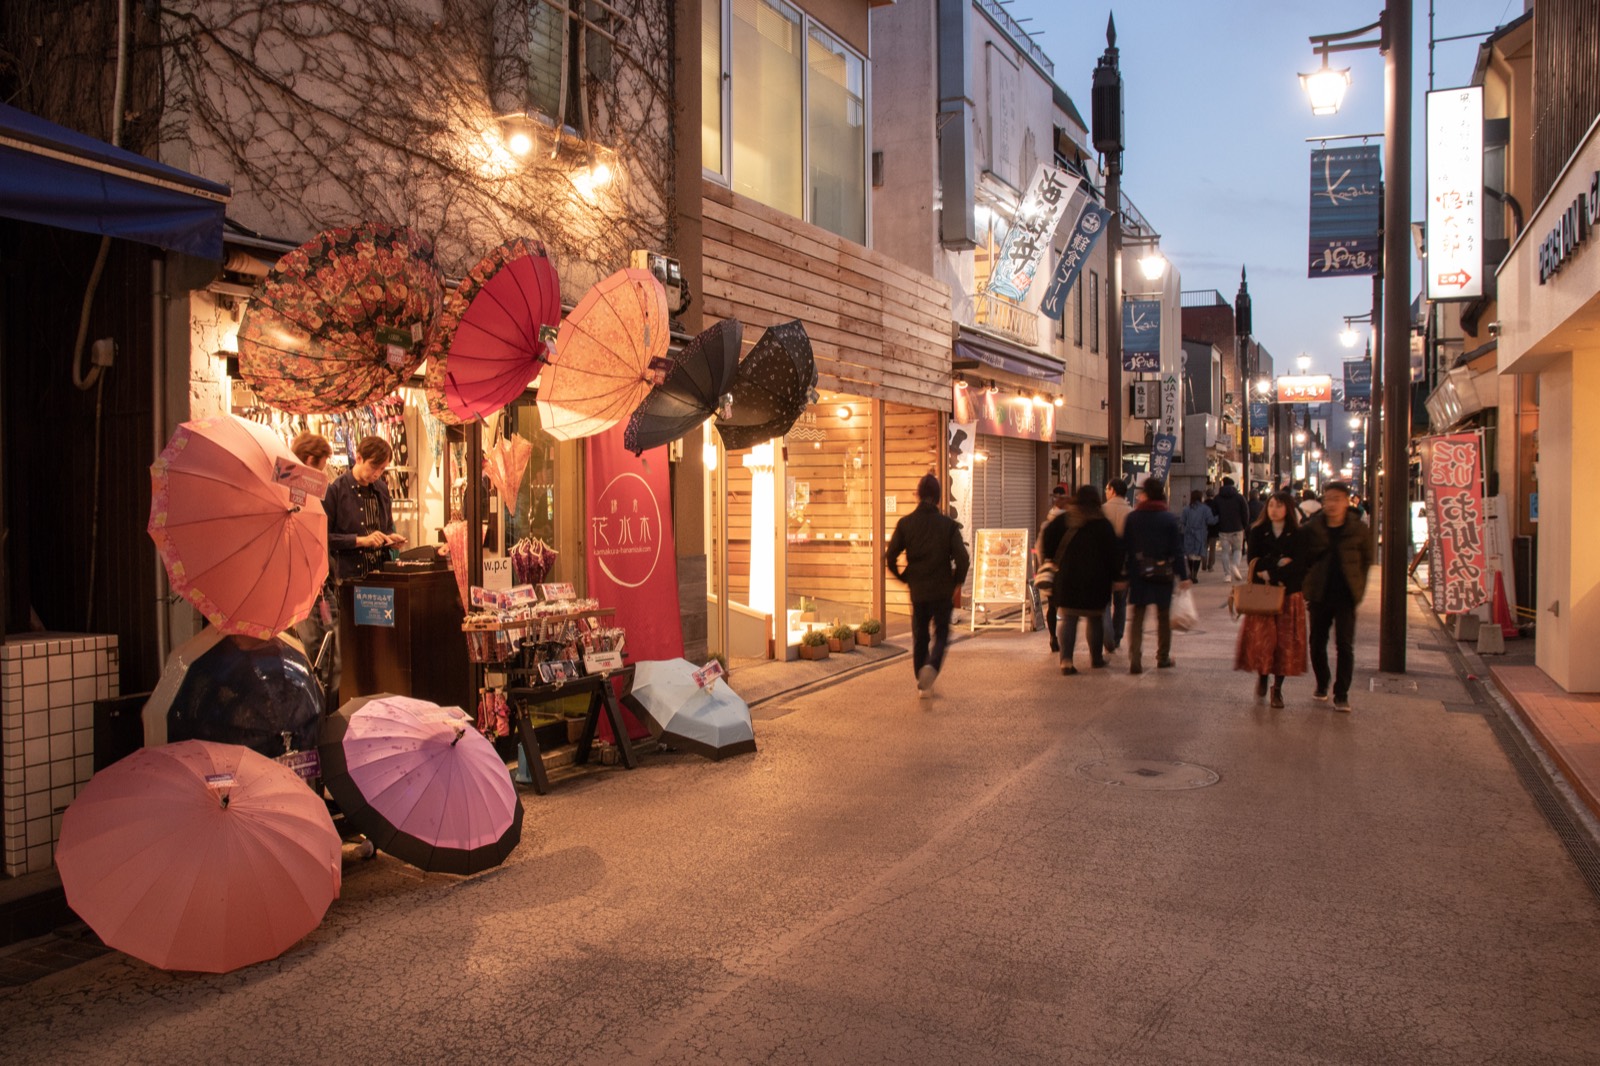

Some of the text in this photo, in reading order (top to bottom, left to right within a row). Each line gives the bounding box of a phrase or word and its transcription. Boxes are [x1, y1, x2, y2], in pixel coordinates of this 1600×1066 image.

[1539, 193, 1586, 285] PERSIAN
[1284, 386, 1325, 397] 小町通り
[592, 516, 652, 546] 花水木
[484, 560, 508, 574] w.p.c
